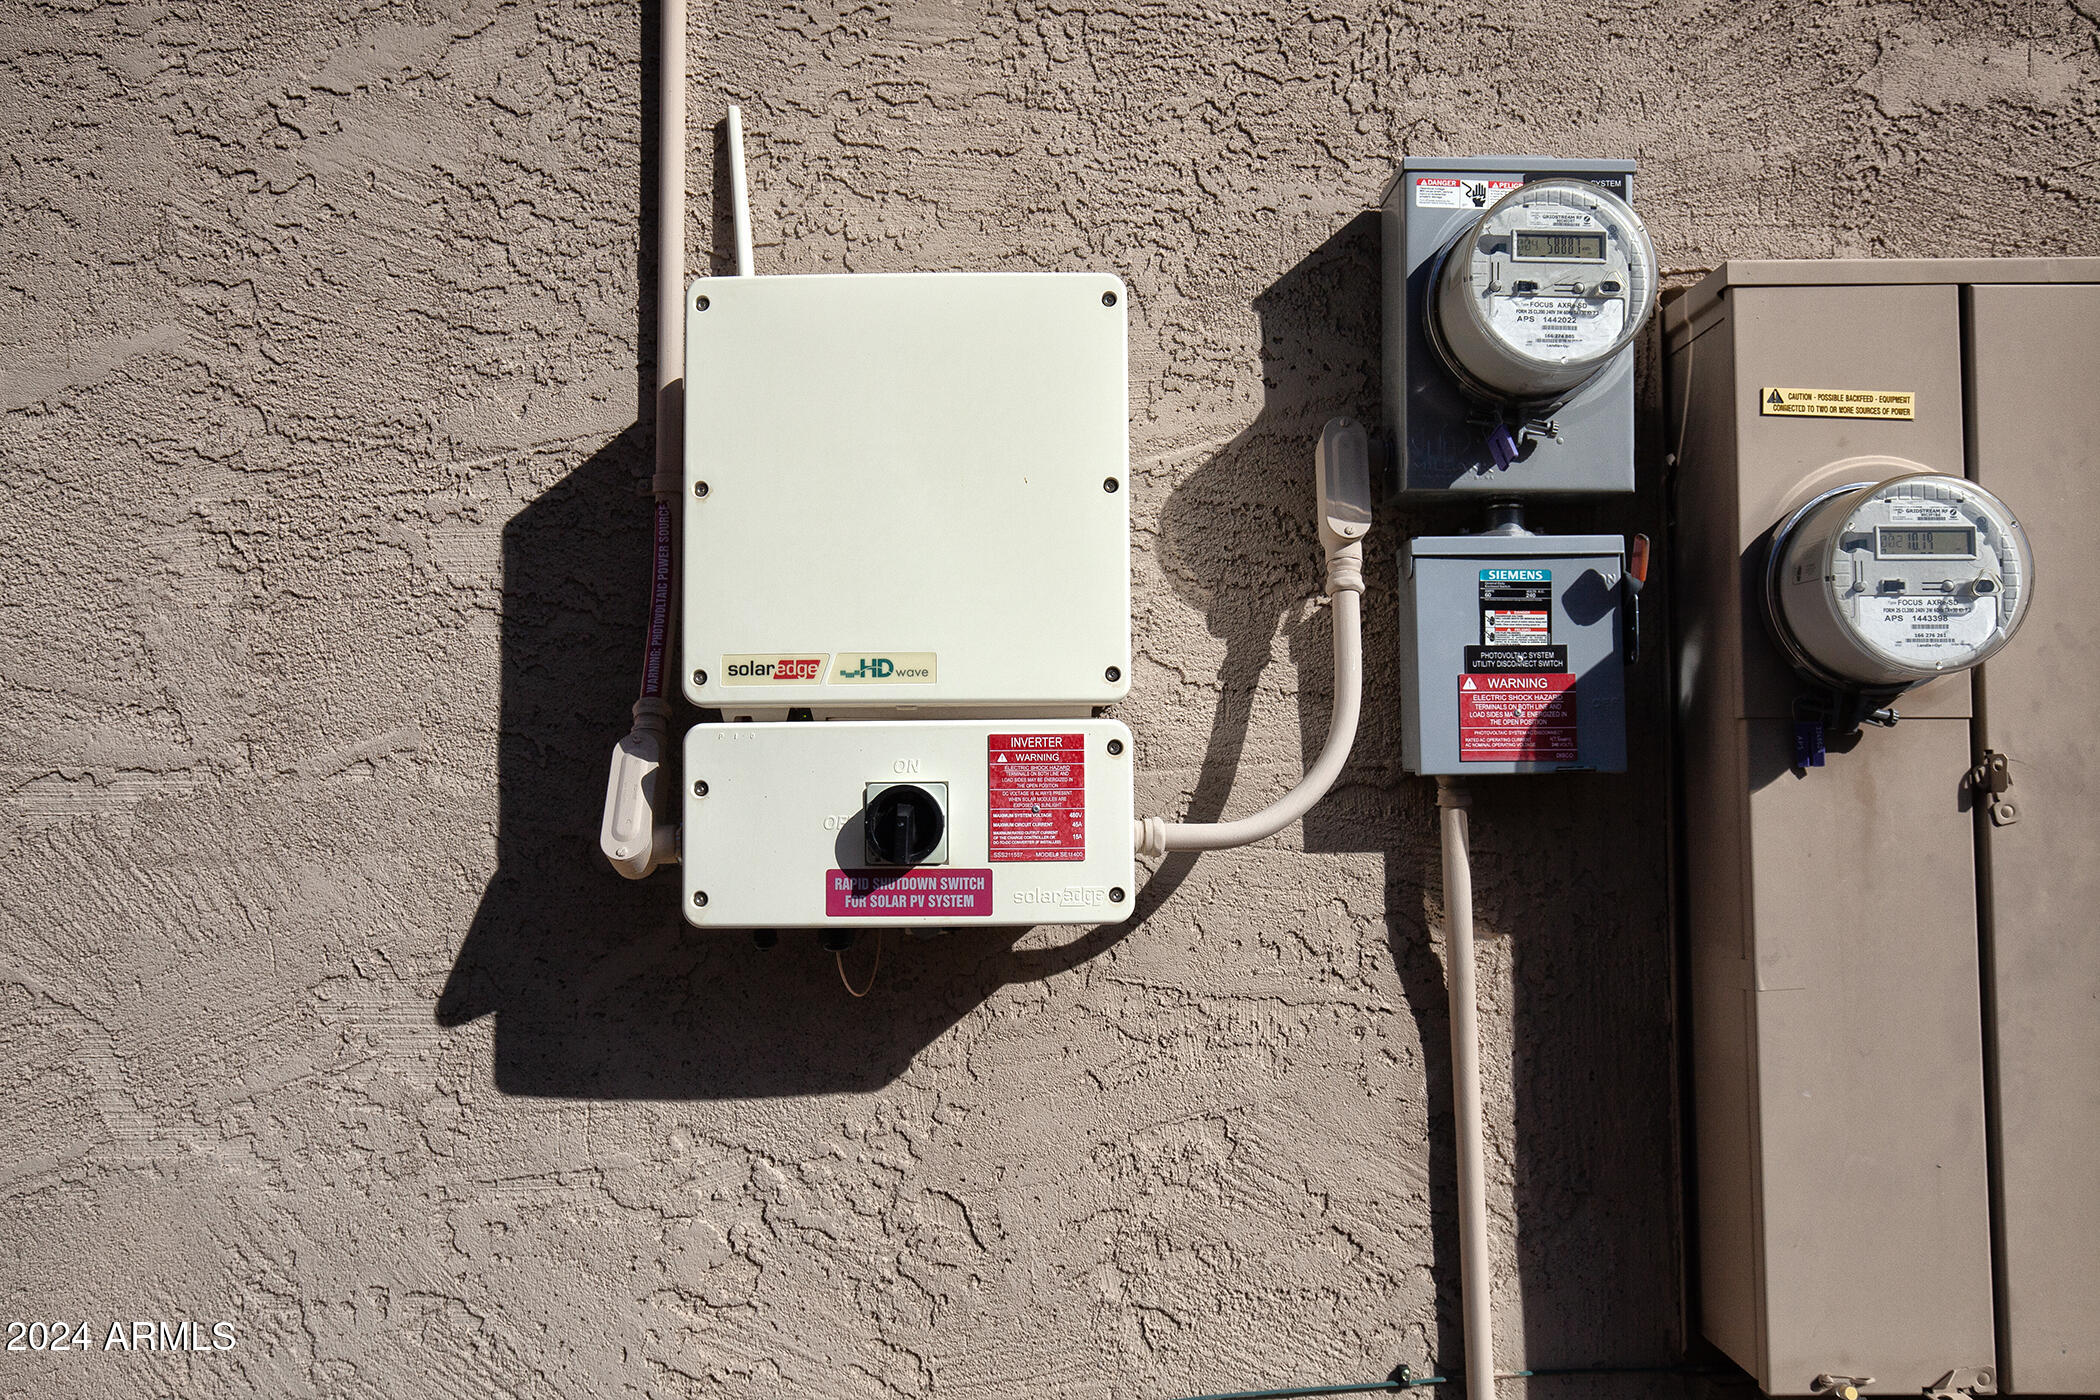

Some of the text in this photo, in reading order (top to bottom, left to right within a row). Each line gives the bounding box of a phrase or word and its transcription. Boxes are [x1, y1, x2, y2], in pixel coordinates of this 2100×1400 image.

[1818, 394, 1844, 402] POSSIBLE
[1846, 395, 1874, 403] BACKFEED
[1879, 396, 1911, 404] EQUIPMENT
[1773, 404, 1805, 412] CONNECTED
[1807, 405, 1814, 413] TO
[1830, 406, 1837, 414] OR
[1856, 407, 1881, 415] SOURCES
[1891, 408, 1911, 416] POWER
[658, 504, 670, 543] SOURCE
[657, 545, 670, 580] POWER
[1489, 570, 1543, 580] SIEMENS
[651, 584, 667, 646] PHOTOVOLTAIC
[728, 660, 819, 678] solaredge
[860, 658, 929, 678] HD wave
[1488, 678, 1548, 688] WARNING
[1011, 737, 1063, 748] INVERTER
[1016, 753, 1060, 761] WARNING
[893, 760, 919, 774] ON
[823, 816, 849, 831] OF
[835, 878, 985, 890] RAPID SHUTDOWN SWITCH
[845, 895, 974, 908] FOR SOLAR PV SYSTEM
